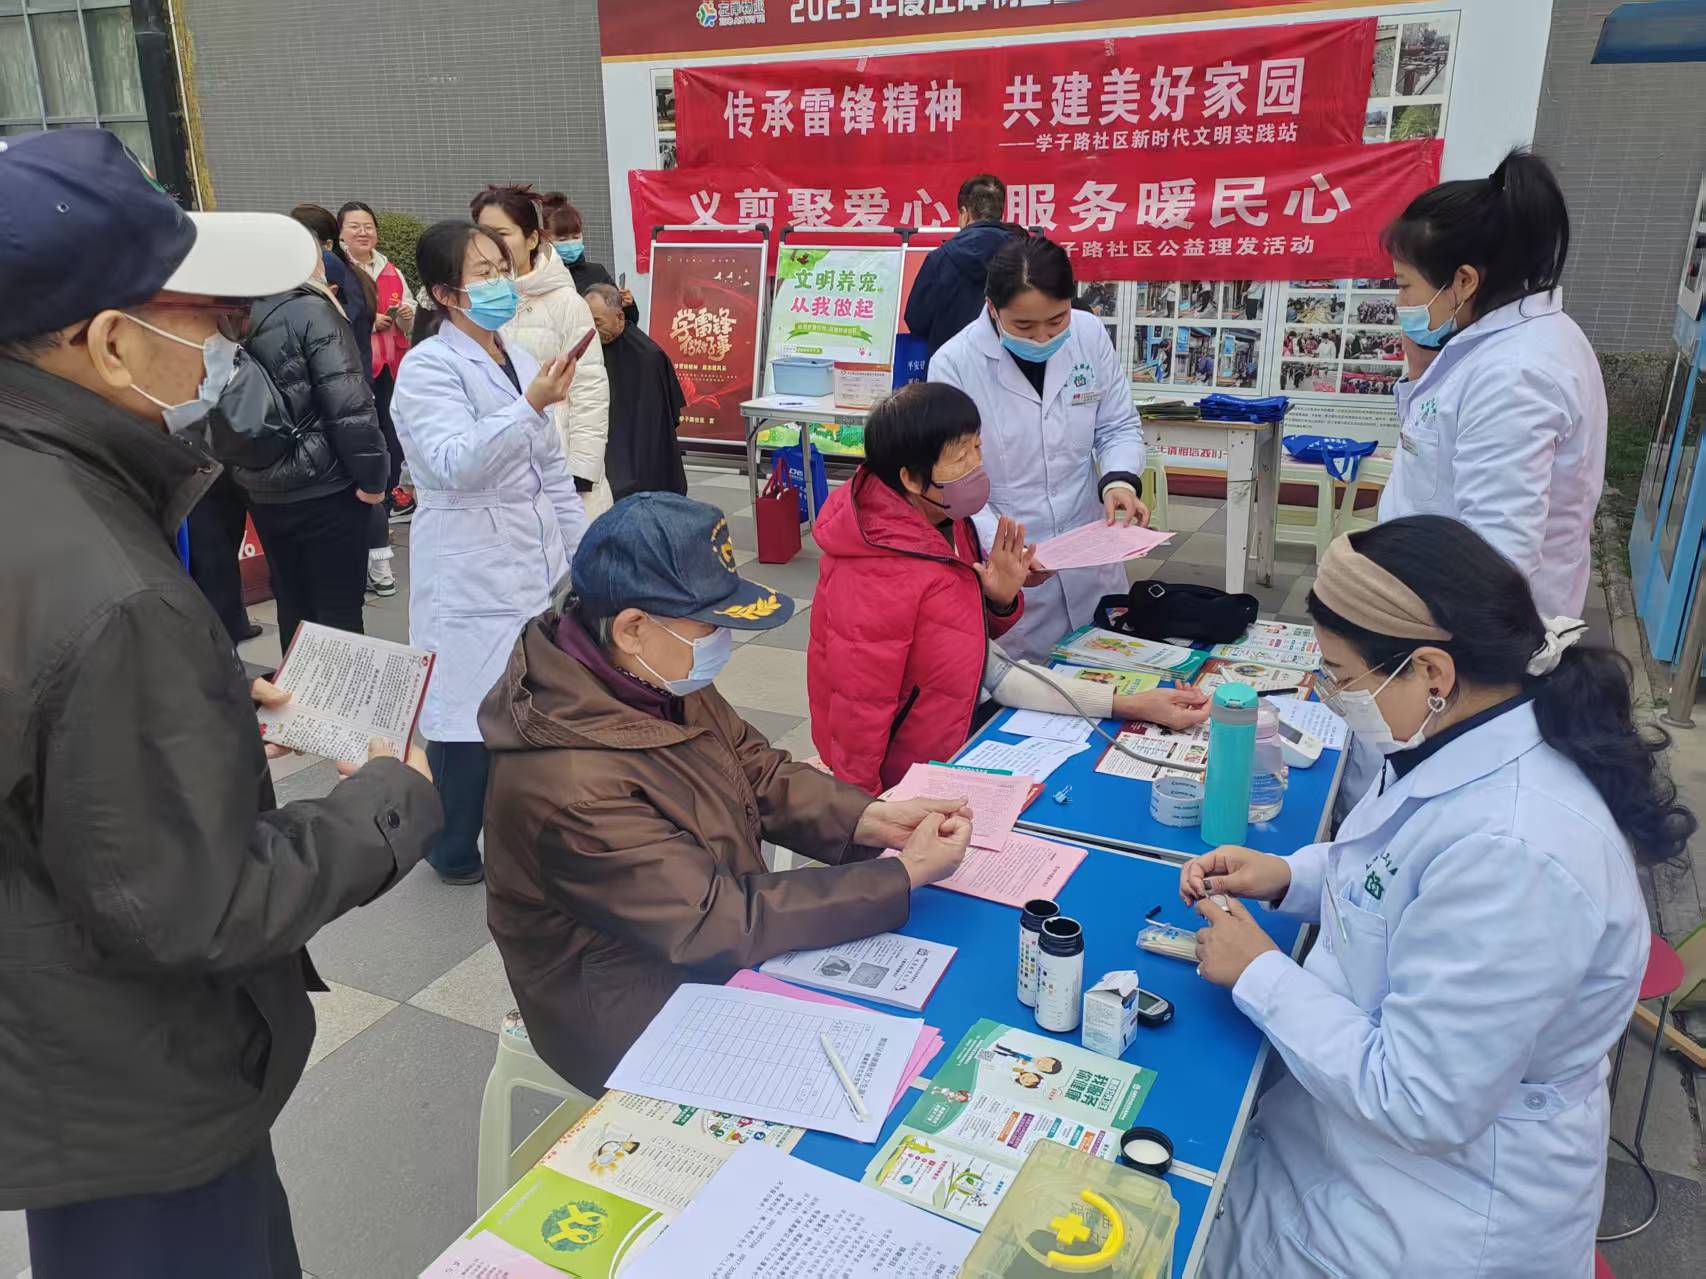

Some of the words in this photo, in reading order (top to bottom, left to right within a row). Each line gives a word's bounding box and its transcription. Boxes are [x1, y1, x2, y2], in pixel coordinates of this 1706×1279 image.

[723, 79, 963, 140] 传承雷锋精神
[1002, 57, 1305, 130] 共建美好家园
[689, 187, 949, 233] 义剪聚爱心
[1006, 172, 1353, 233] 服务暖民心
[794, 269, 878, 292] 文明养宠
[669, 306, 738, 339] 学雷锋
[790, 296, 875, 319] 从我做起
[1064, 1068, 1093, 1102] 你健康
[1080, 1073, 1109, 1107] 我服务
